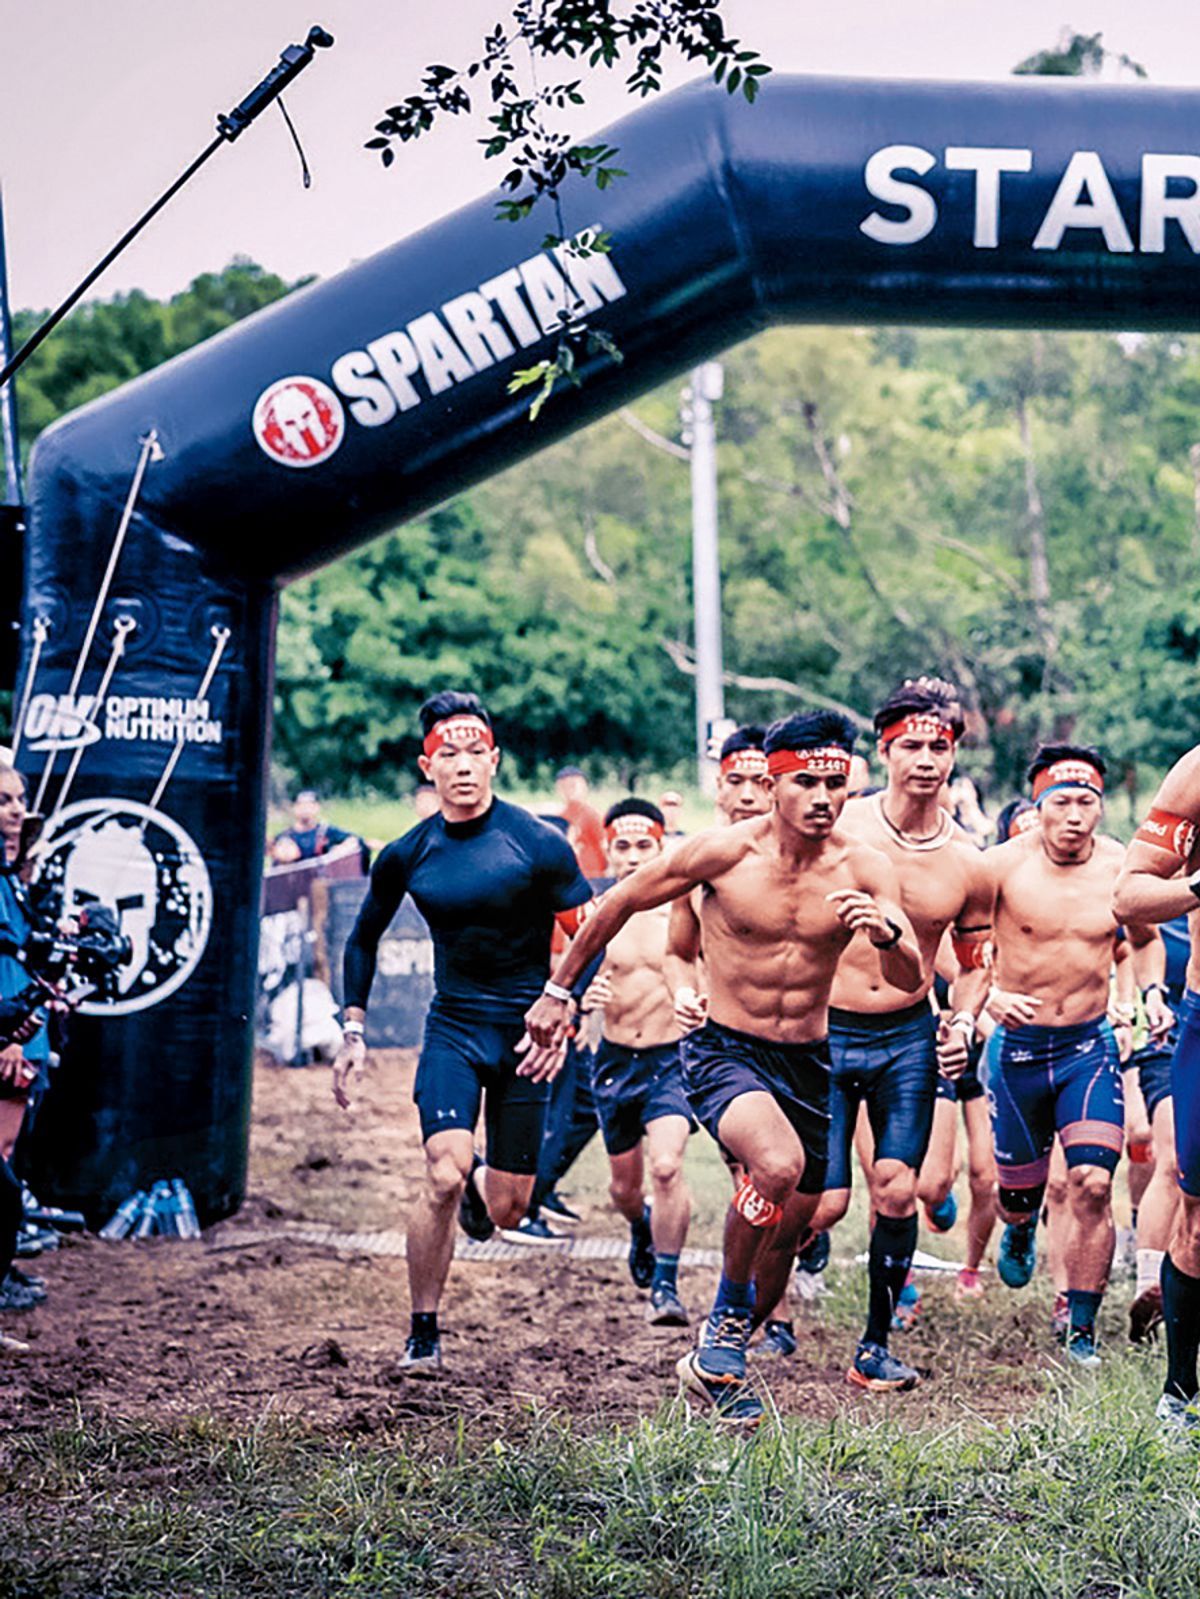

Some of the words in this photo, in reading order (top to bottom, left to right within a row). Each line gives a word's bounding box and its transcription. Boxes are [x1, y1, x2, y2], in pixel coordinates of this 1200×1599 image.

[331, 230, 627, 427] SPARTAN
[105, 696, 209, 719] OPTIMUM
[105, 717, 222, 743] NUTRITION
